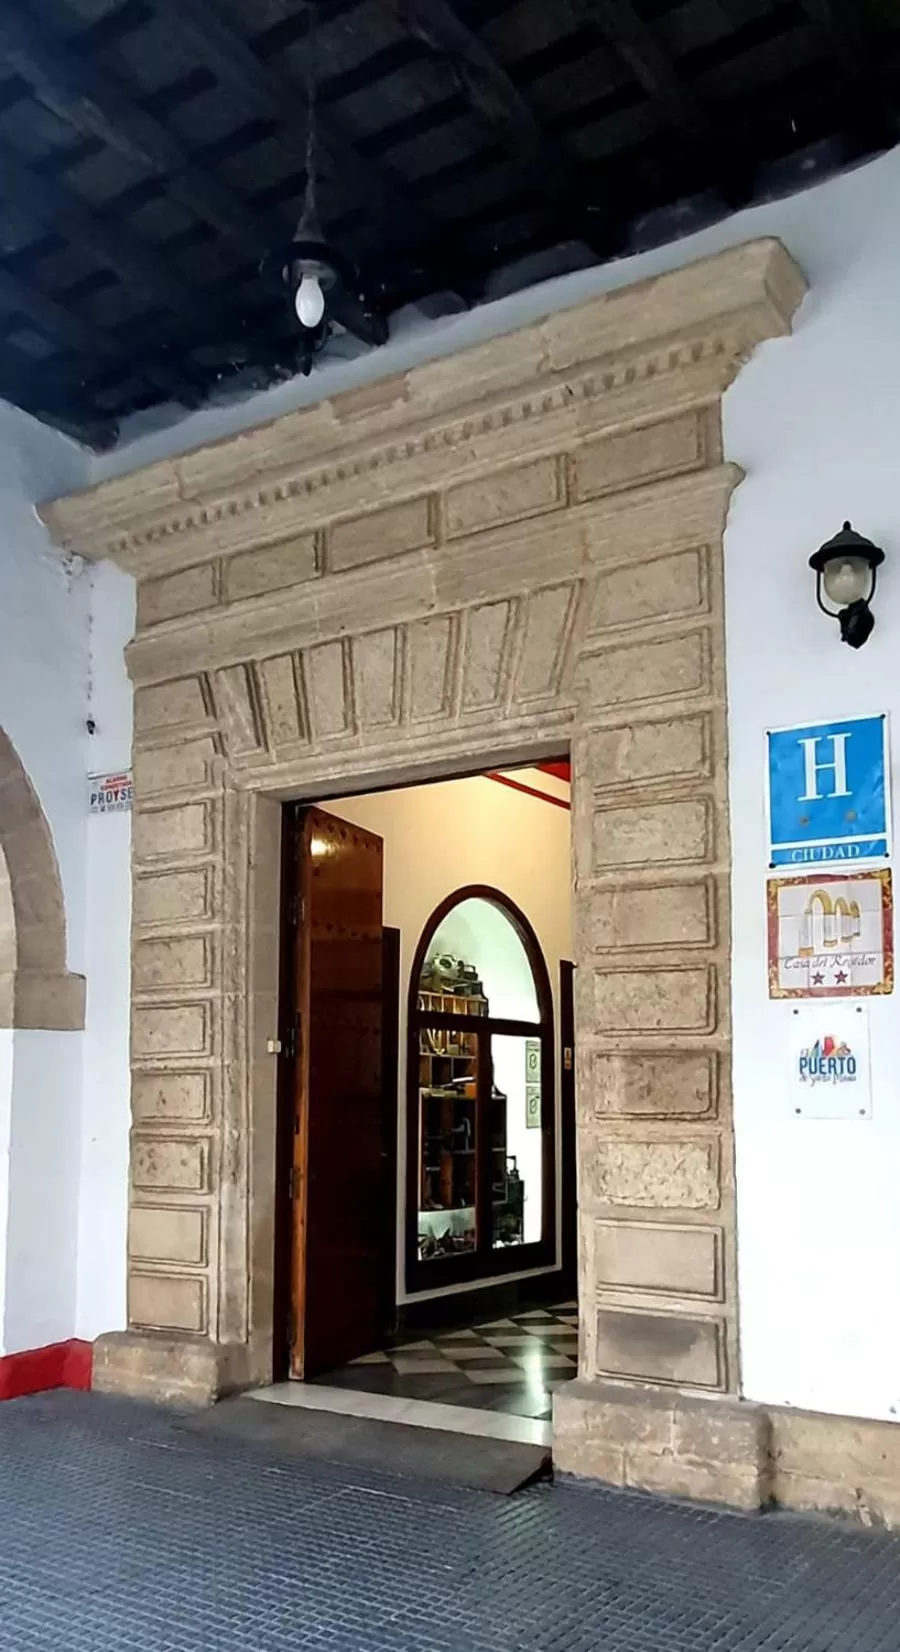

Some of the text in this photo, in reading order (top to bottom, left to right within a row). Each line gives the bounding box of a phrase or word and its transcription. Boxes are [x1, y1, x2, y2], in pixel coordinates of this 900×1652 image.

[797, 732, 852, 802] H
[791, 845, 860, 862] CIUDAD
[783, 956, 810, 970] Casa
[811, 955, 827, 968] del
[799, 1056, 856, 1075] PUERTO
